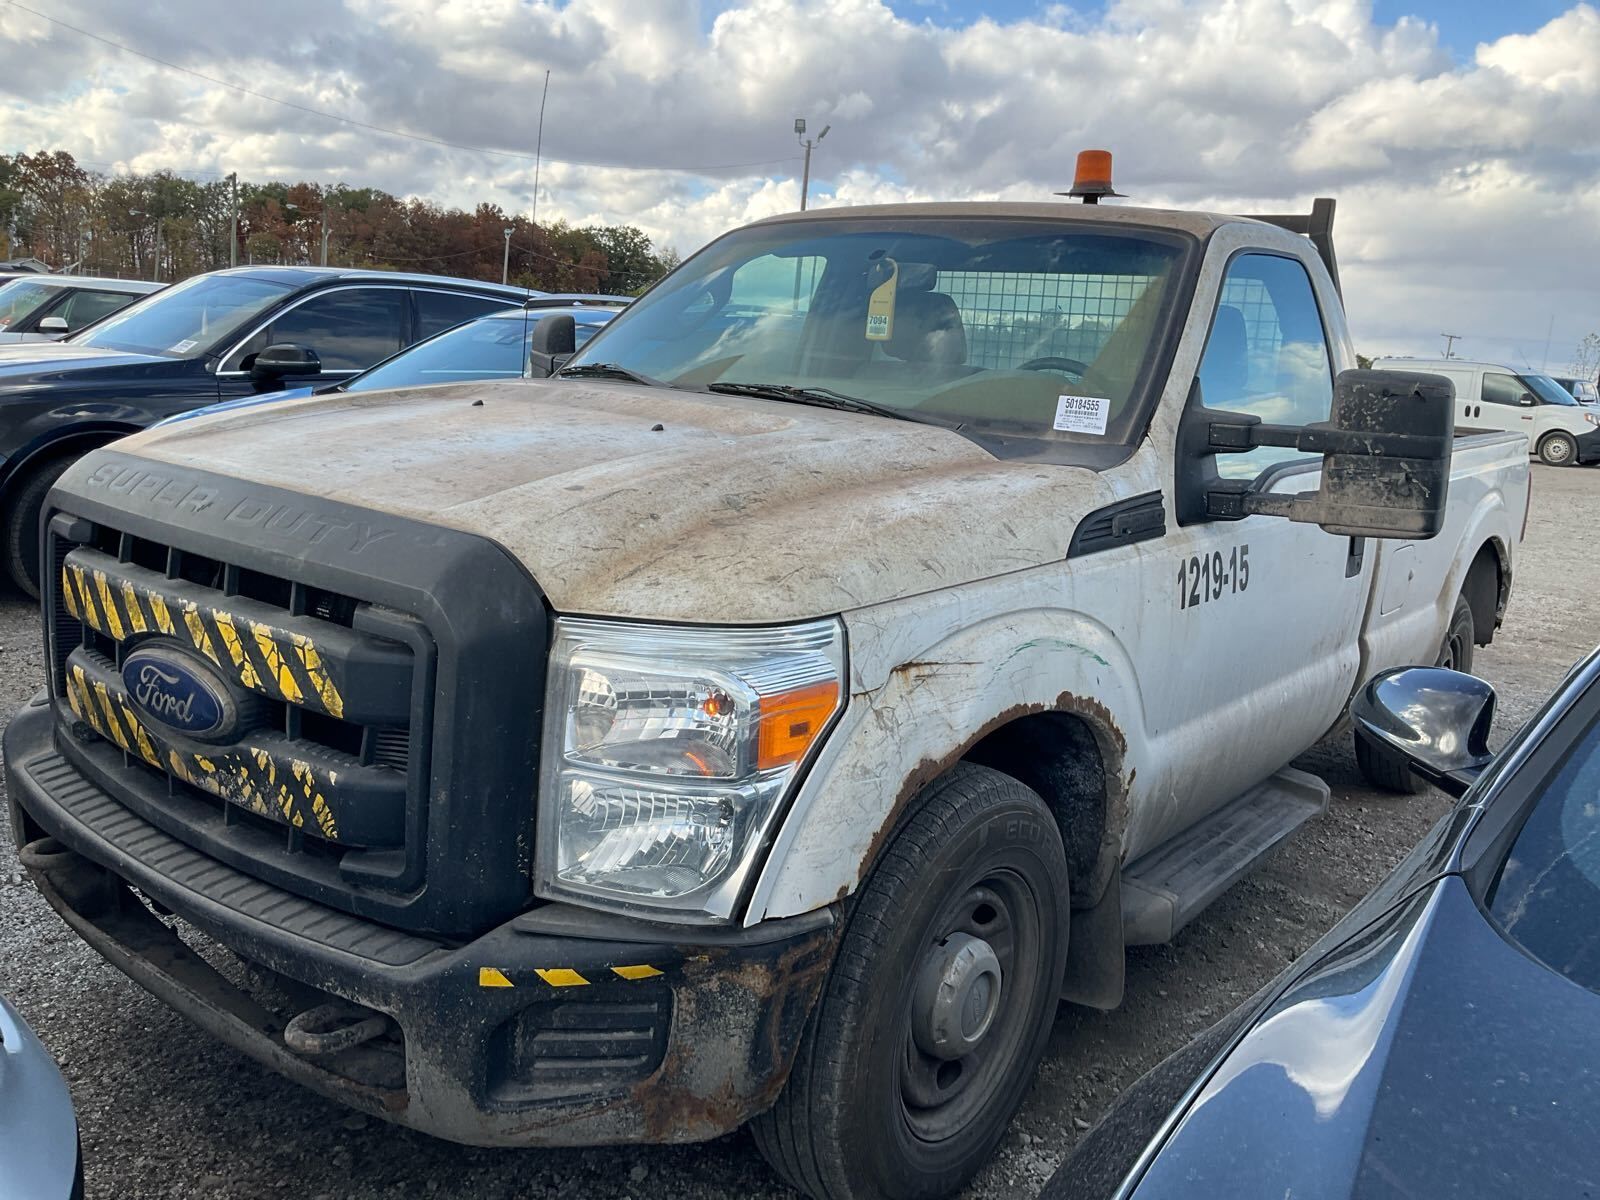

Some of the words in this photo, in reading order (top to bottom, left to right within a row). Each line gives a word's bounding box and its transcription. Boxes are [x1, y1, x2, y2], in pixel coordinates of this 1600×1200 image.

[869, 316, 887, 325] 7094
[1065, 398, 1100, 411] 50184555
[87, 462, 219, 513] SUPER
[223, 496, 398, 554] DUTY
[1177, 544, 1249, 610] 1219-15
[136, 664, 195, 723] Ford
